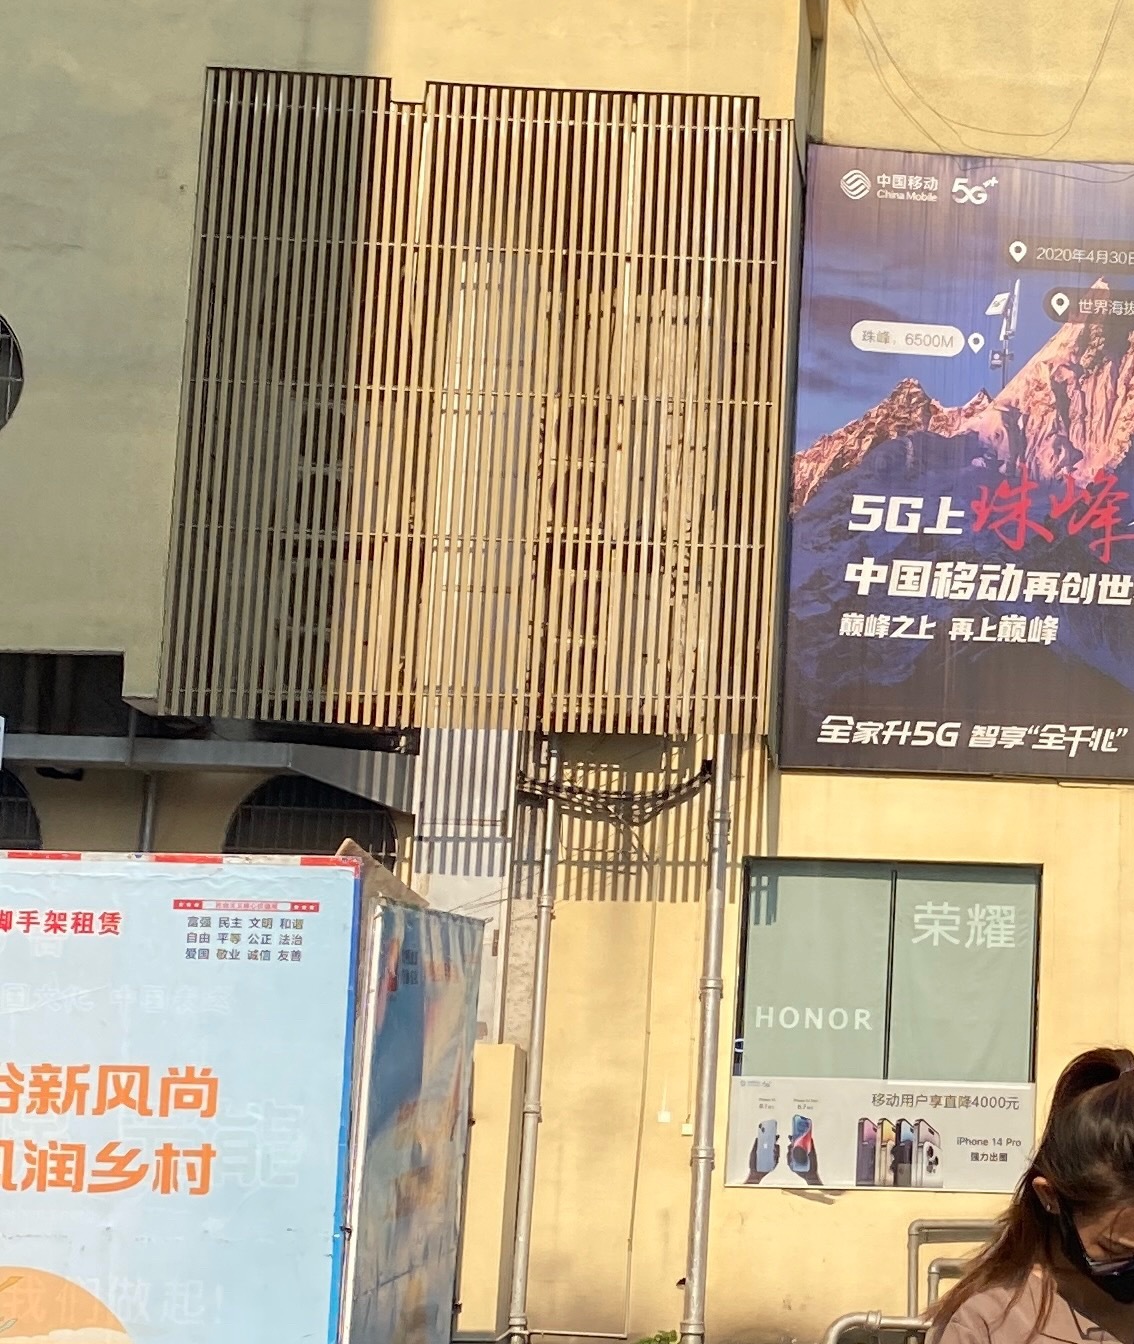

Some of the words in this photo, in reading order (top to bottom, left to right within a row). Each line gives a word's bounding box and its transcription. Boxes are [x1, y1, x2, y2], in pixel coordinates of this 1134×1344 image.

[877, 173, 939, 191] 中国移动
[876, 189, 904, 200] China
[906, 191, 938, 202] Mobile
[839, 613, 935, 641] 巅峰之上
[948, 613, 1059, 646] 再上巅峰
[817, 714, 962, 747] 全家升5G
[187, 916, 211, 928] 富强
[218, 917, 242, 929] 民主
[248, 917, 273, 929] 文明
[280, 918, 304, 930] 和谐
[911, 901, 1016, 949] 荣耀
[186, 932, 210, 944] 自由
[248, 933, 272, 945] 公正
[279, 934, 303, 946] 法治
[185, 948, 210, 960] 爱国
[216, 948, 240, 960] 敬业
[247, 949, 271, 961] 诚信
[277, 950, 301, 962] 友善
[755, 1006, 873, 1031] HONOR
[871, 1093, 1020, 1110] 移动用户享直降4000元
[957, 1136, 988, 1146] iPhone
[992, 1137, 1003, 1146] 14
[1006, 1138, 1022, 1147] Pro
[0, 1139, 217, 1195] 润乡村
